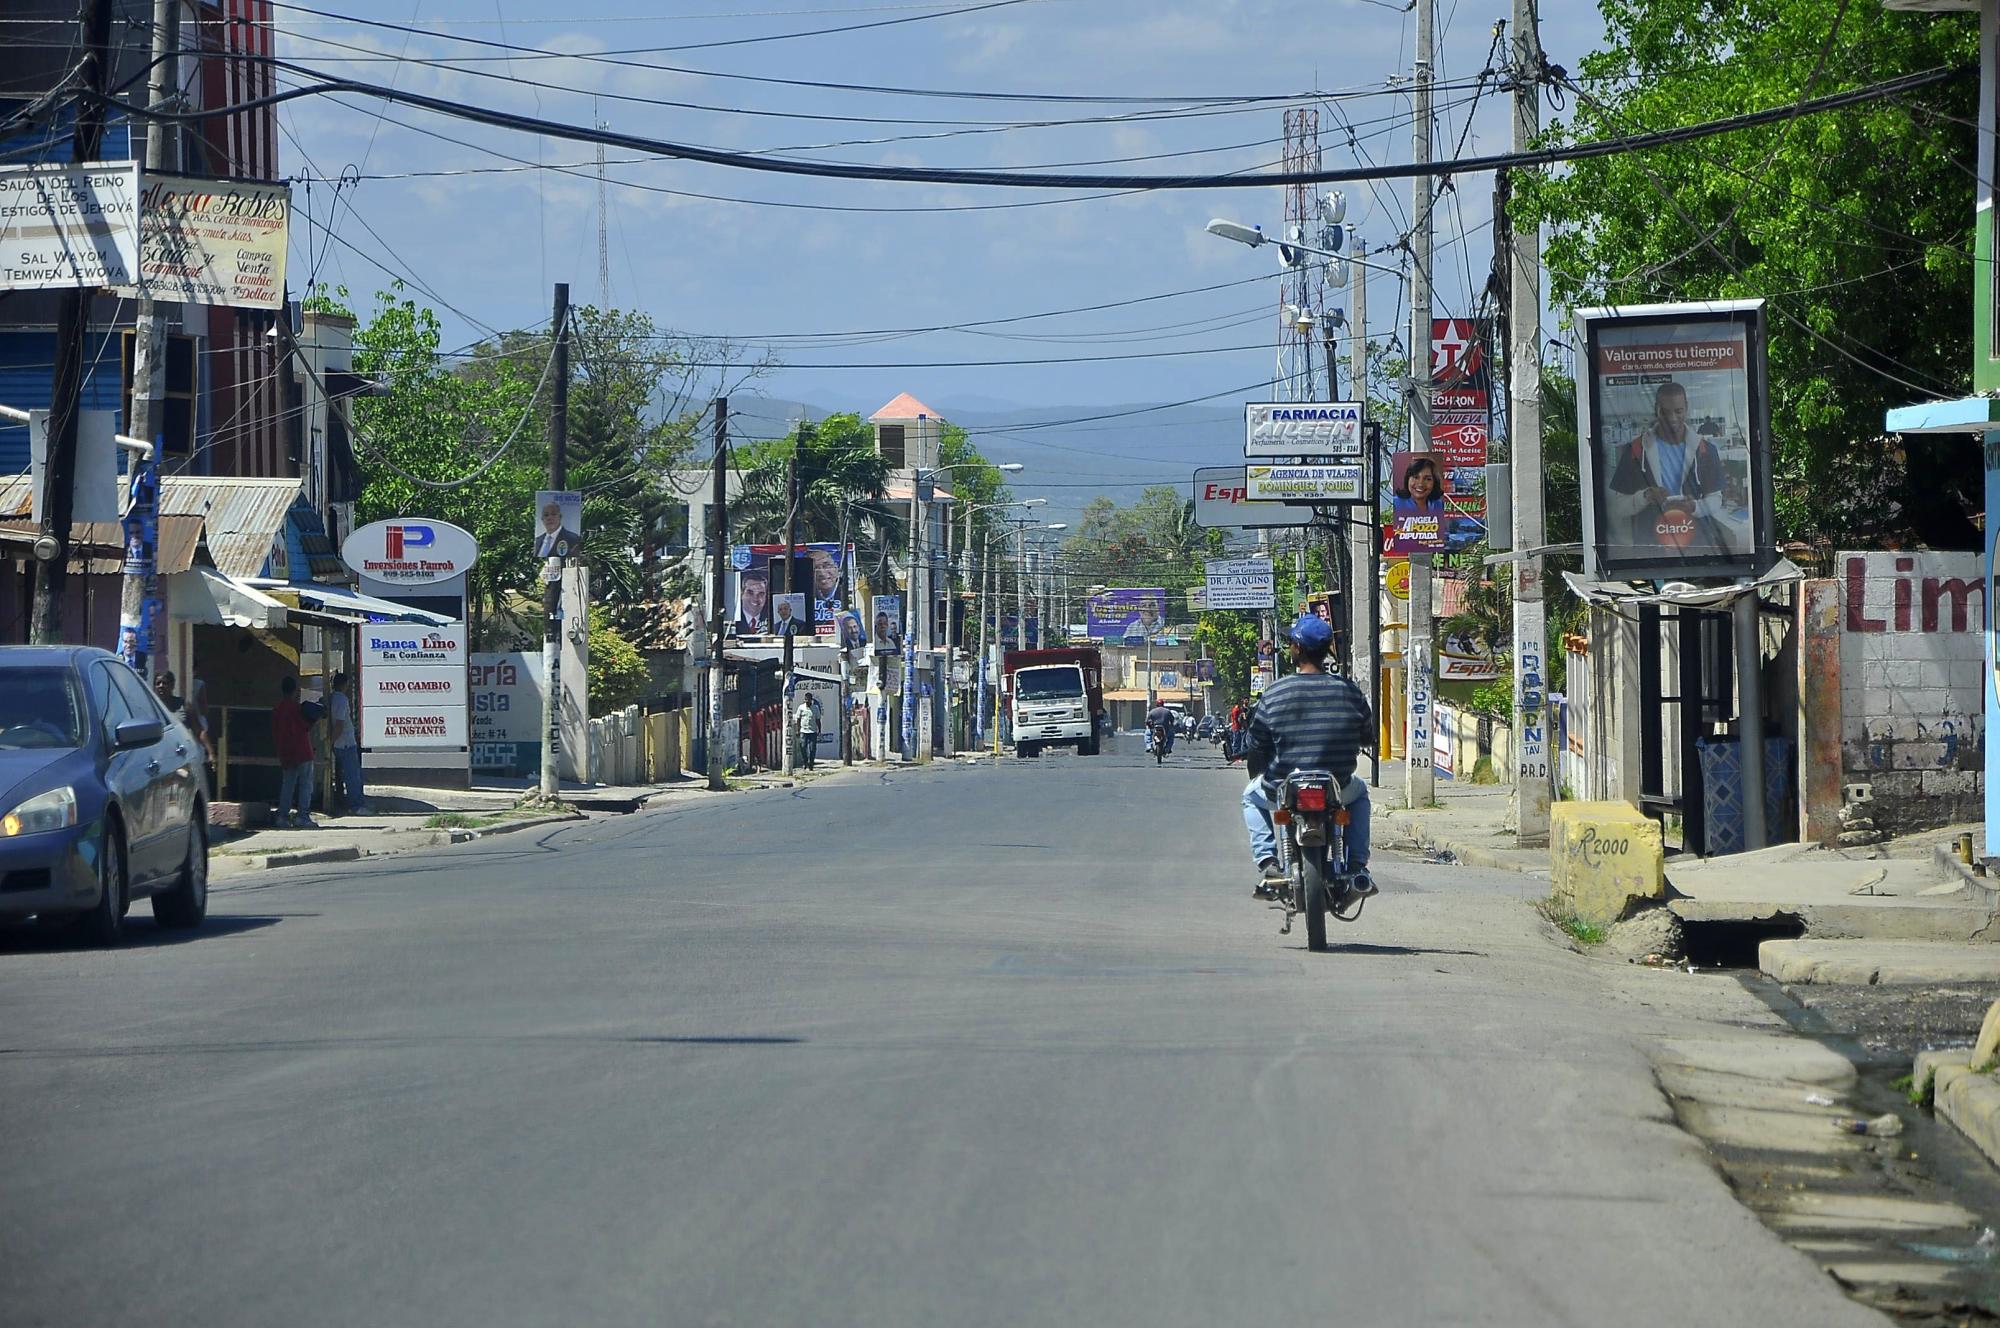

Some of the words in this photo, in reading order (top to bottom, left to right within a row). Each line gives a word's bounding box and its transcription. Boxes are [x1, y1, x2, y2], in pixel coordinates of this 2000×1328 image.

[51, 177, 77, 189] DEL
[84, 176, 124, 188] REINO
[37, 192, 55, 204] DE
[61, 191, 88, 202] LOS
[60, 205, 76, 215] DE
[81, 197, 133, 214] JEHOVÁ
[213, 190, 285, 221] Robles
[21, 253, 47, 264] SAL
[237, 248, 272, 261] Compra
[237, 261, 270, 274] Venta
[4, 269, 61, 280] TEMWEN
[68, 268, 124, 279] JEWOVA
[235, 273, 272, 286] cambio
[240, 287, 276, 301] Dollar
[1605, 350, 1673, 362] Valoramos
[1675, 348, 1687, 359] tu
[1690, 346, 1734, 360] tiempo
[1272, 409, 1357, 420] FARMACIA
[1446, 414, 1482, 424] NUEVA
[1254, 421, 1354, 438] AILEEN
[1270, 469, 1308, 478] AGENCIA
[1311, 469, 1324, 478] DE
[1326, 469, 1358, 478] VIAJES
[1258, 481, 1318, 492] DOMINGUEZ
[1321, 481, 1354, 492] TOURS
[1204, 484, 1247, 503] Esp
[1412, 524, 1440, 532] POZO
[1399, 532, 1438, 540] DIPUTADA
[364, 560, 418, 570] Inversiones
[420, 560, 454, 570] Panrob
[1236, 576, 1269, 585] AQUINO
[370, 638, 417, 649] Banca
[421, 638, 456, 649] Lino
[399, 651, 446, 659] Confianza
[471, 659, 517, 685] ería
[379, 682, 405, 690] LINO
[408, 681, 451, 690] CAMBIO
[386, 716, 445, 725] PRESTAMOS
[384, 726, 397, 735] AL
[399, 726, 446, 735] INSTANTE
[1524, 746, 1542, 756] TAV.
[1411, 758, 1431, 769] P.R.D.
[1521, 764, 1549, 777] P.R.D.
